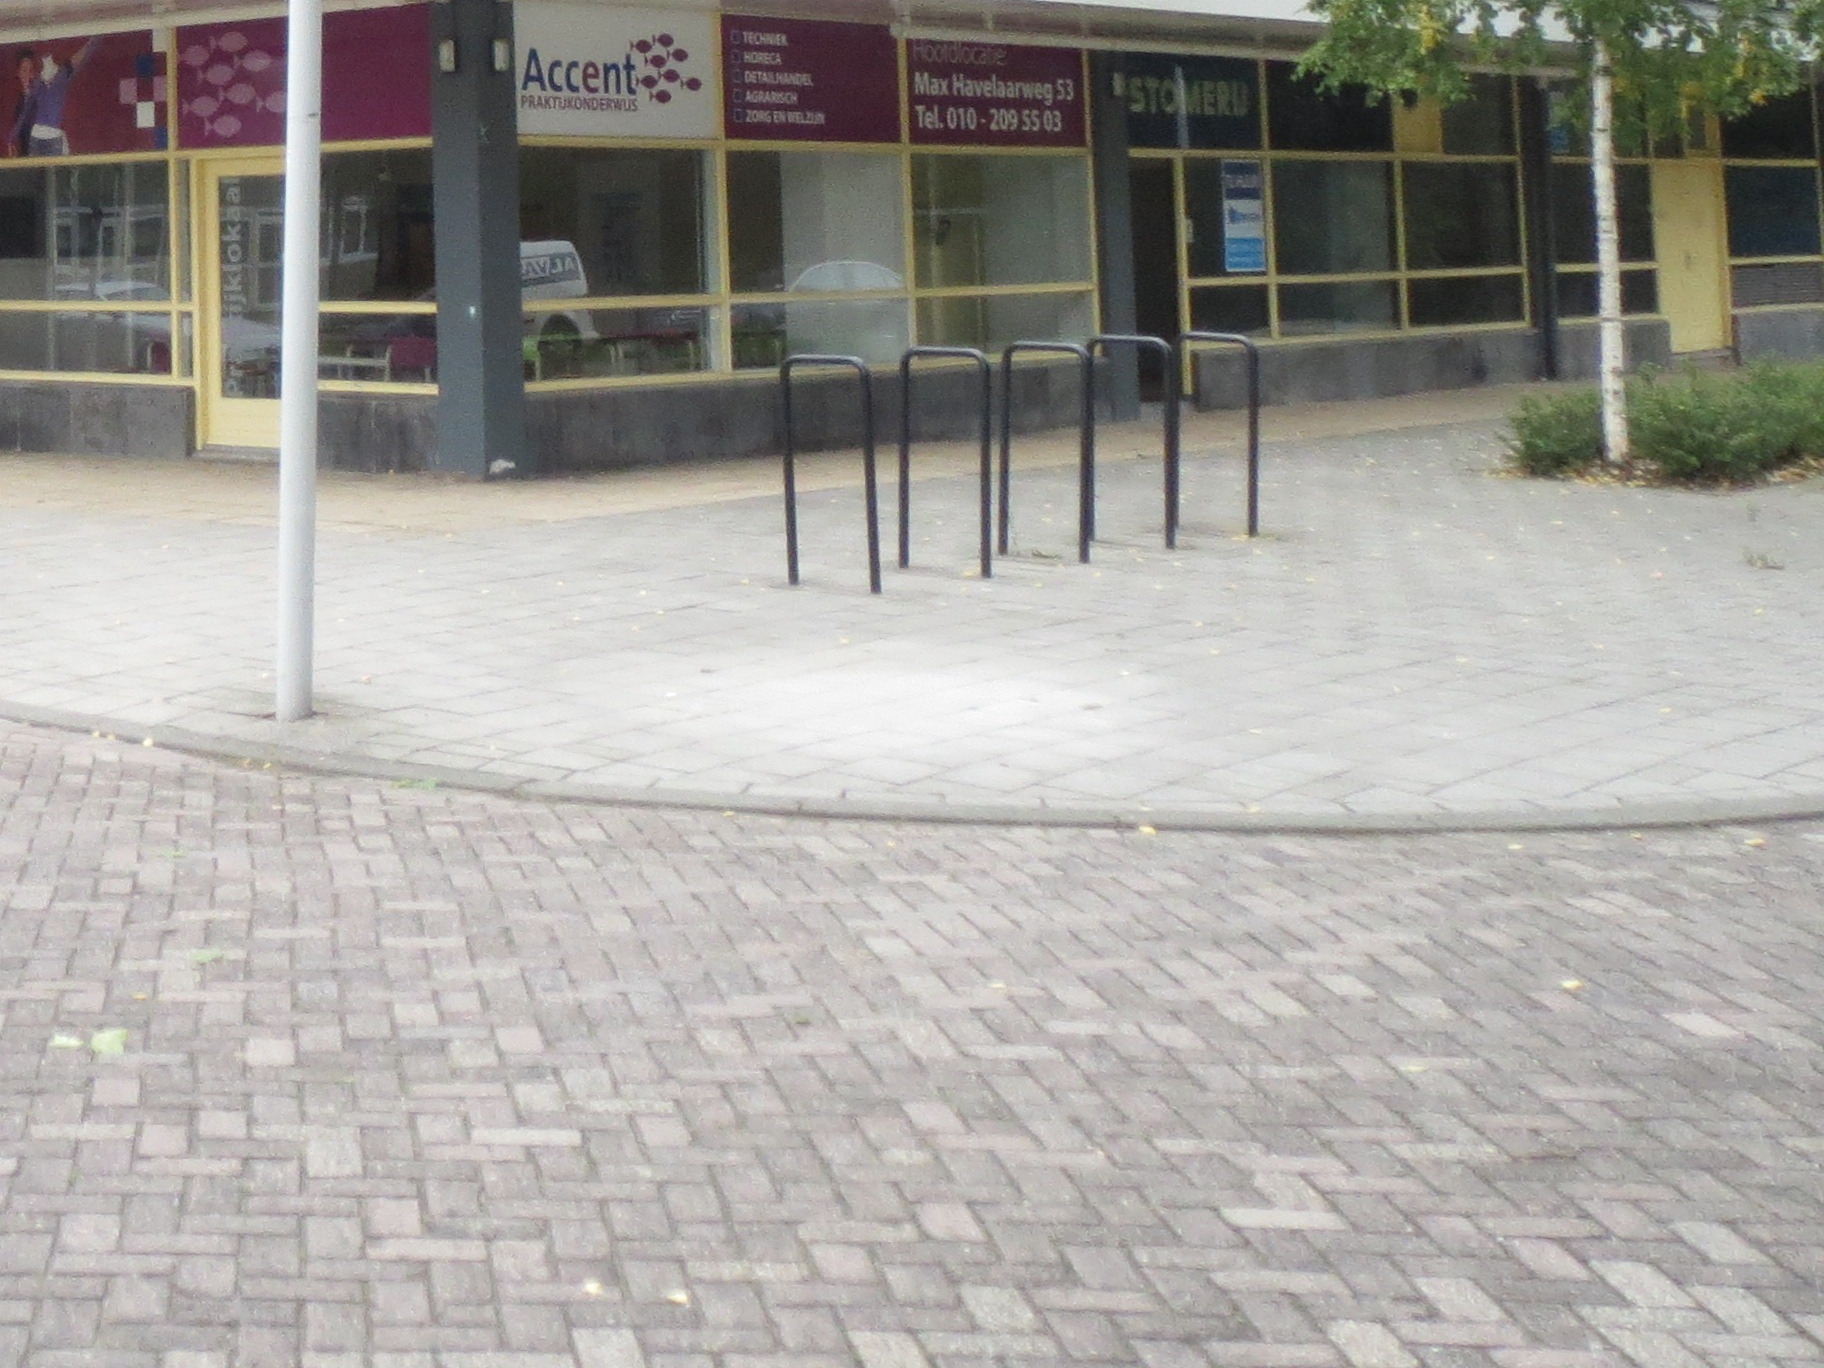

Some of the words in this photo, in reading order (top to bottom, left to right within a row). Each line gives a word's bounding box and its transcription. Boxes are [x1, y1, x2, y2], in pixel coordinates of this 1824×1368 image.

[521, 47, 637, 96] Accent
[914, 71, 949, 96] Max
[952, 73, 1053, 107] Havelaarweg
[1056, 78, 1074, 101] 53
[915, 105, 944, 130] Tel.
[947, 107, 976, 130] 010
[989, 108, 1018, 131] 209
[1022, 109, 1040, 132] 55
[1043, 110, 1062, 133] 03
